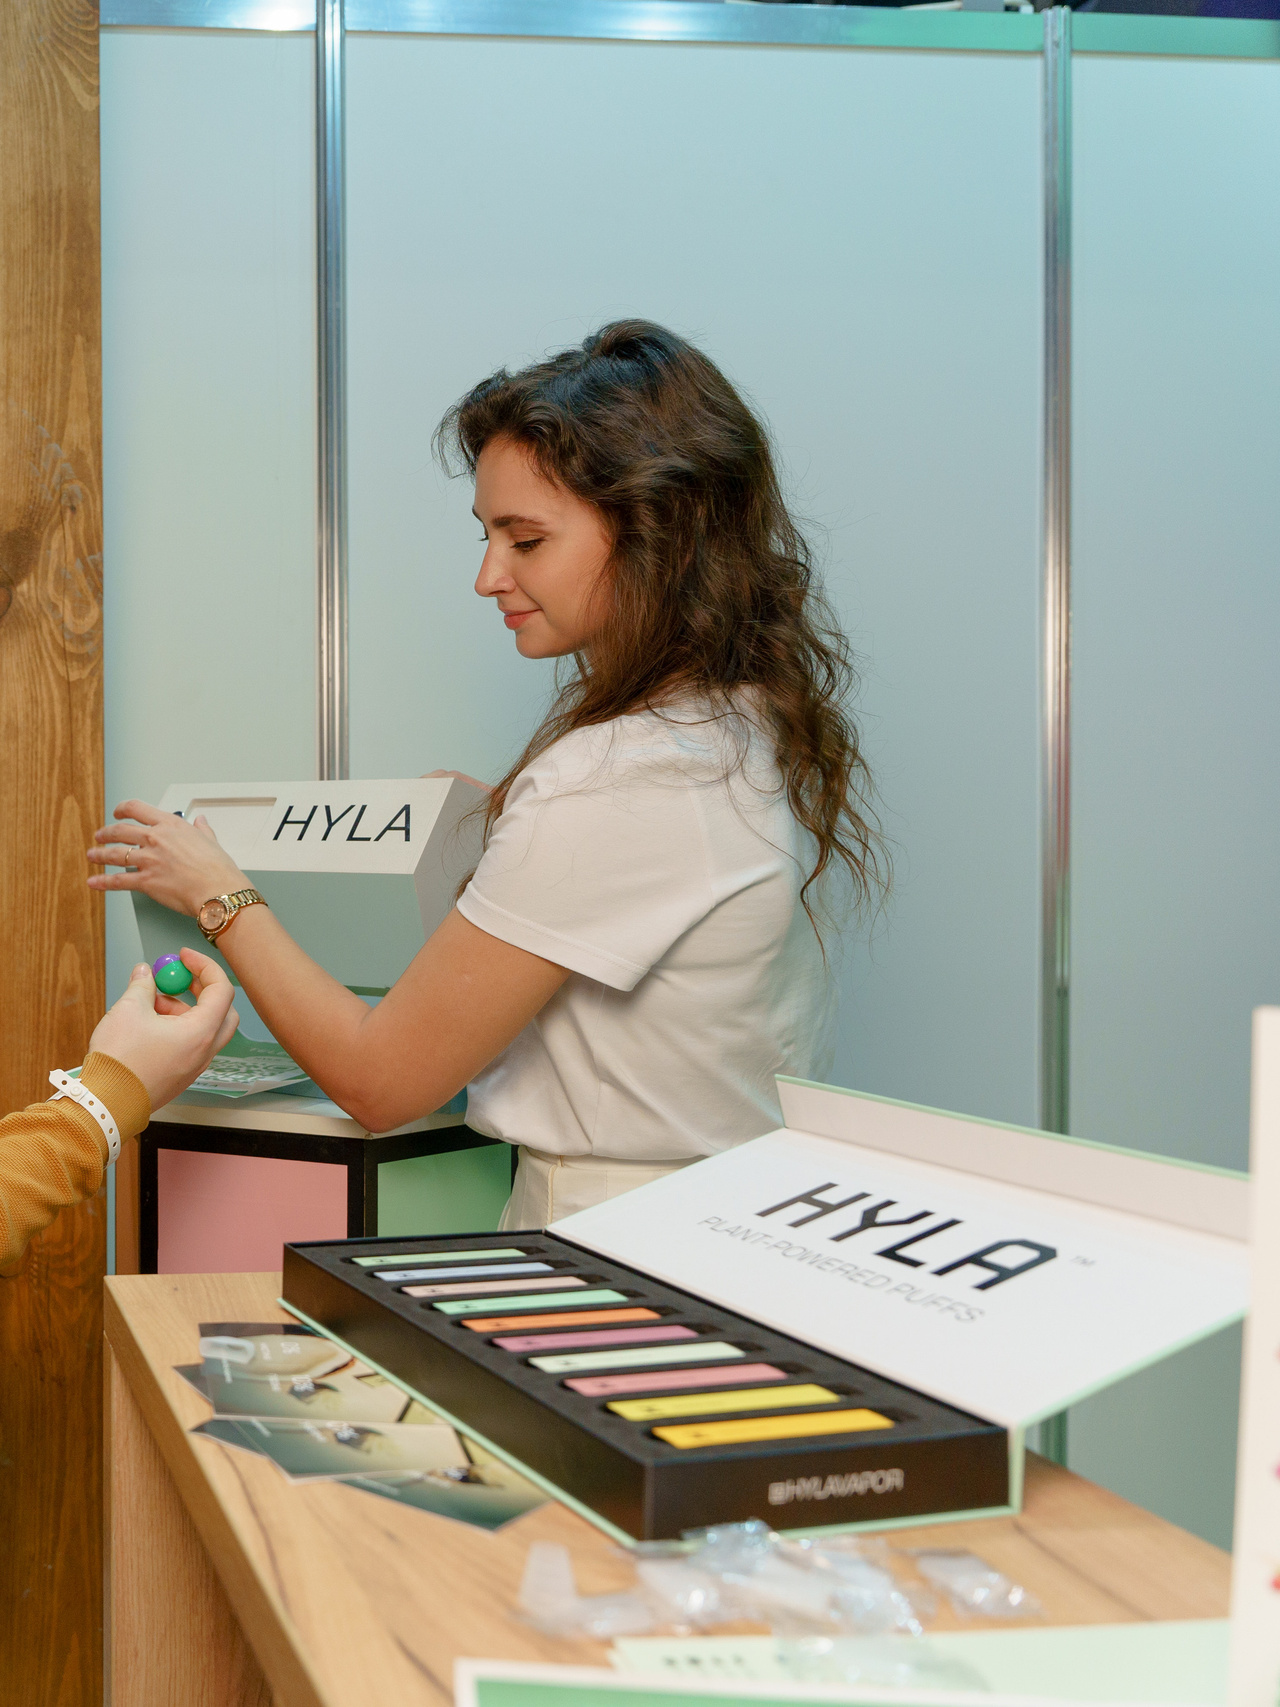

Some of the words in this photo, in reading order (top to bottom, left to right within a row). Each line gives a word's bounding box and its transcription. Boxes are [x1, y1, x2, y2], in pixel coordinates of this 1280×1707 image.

[272, 803, 411, 842] HYLA
[697, 1215, 891, 1290] PLANT-POWERED
[886, 1282, 985, 1324] PUFFS
[754, 1182, 1058, 1291] HYLA
